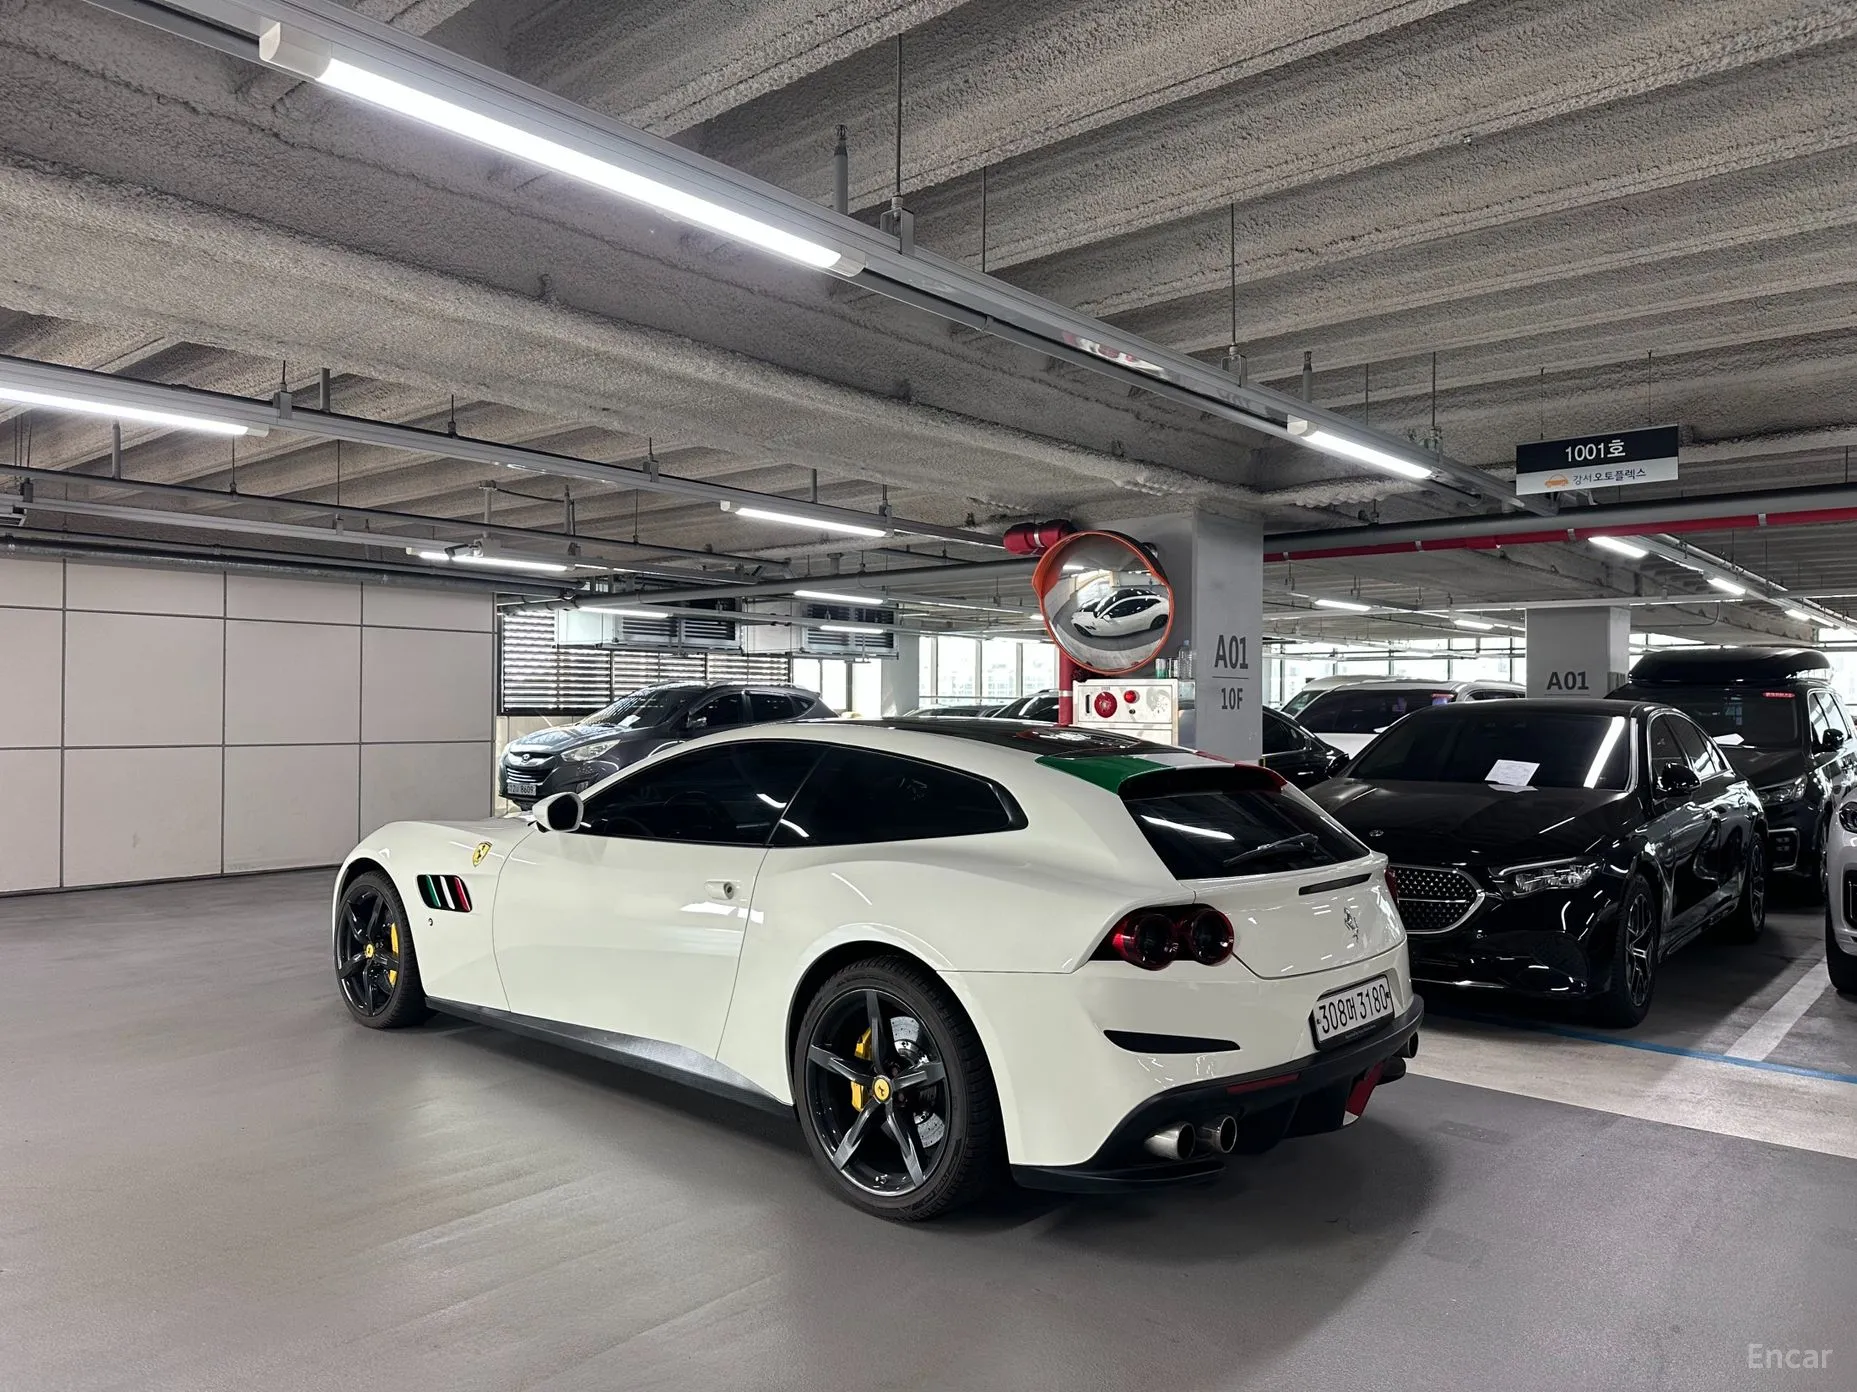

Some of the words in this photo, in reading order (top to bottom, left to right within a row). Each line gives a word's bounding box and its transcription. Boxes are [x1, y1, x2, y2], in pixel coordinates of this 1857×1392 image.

[1565, 439, 1626, 462] 1001호
[1214, 634, 1249, 669] A01
[1546, 671, 1589, 690] A01
[1221, 687, 1243, 710] 10F
[1319, 997, 1358, 1034] 308머
[1357, 984, 1388, 1020] 3180
